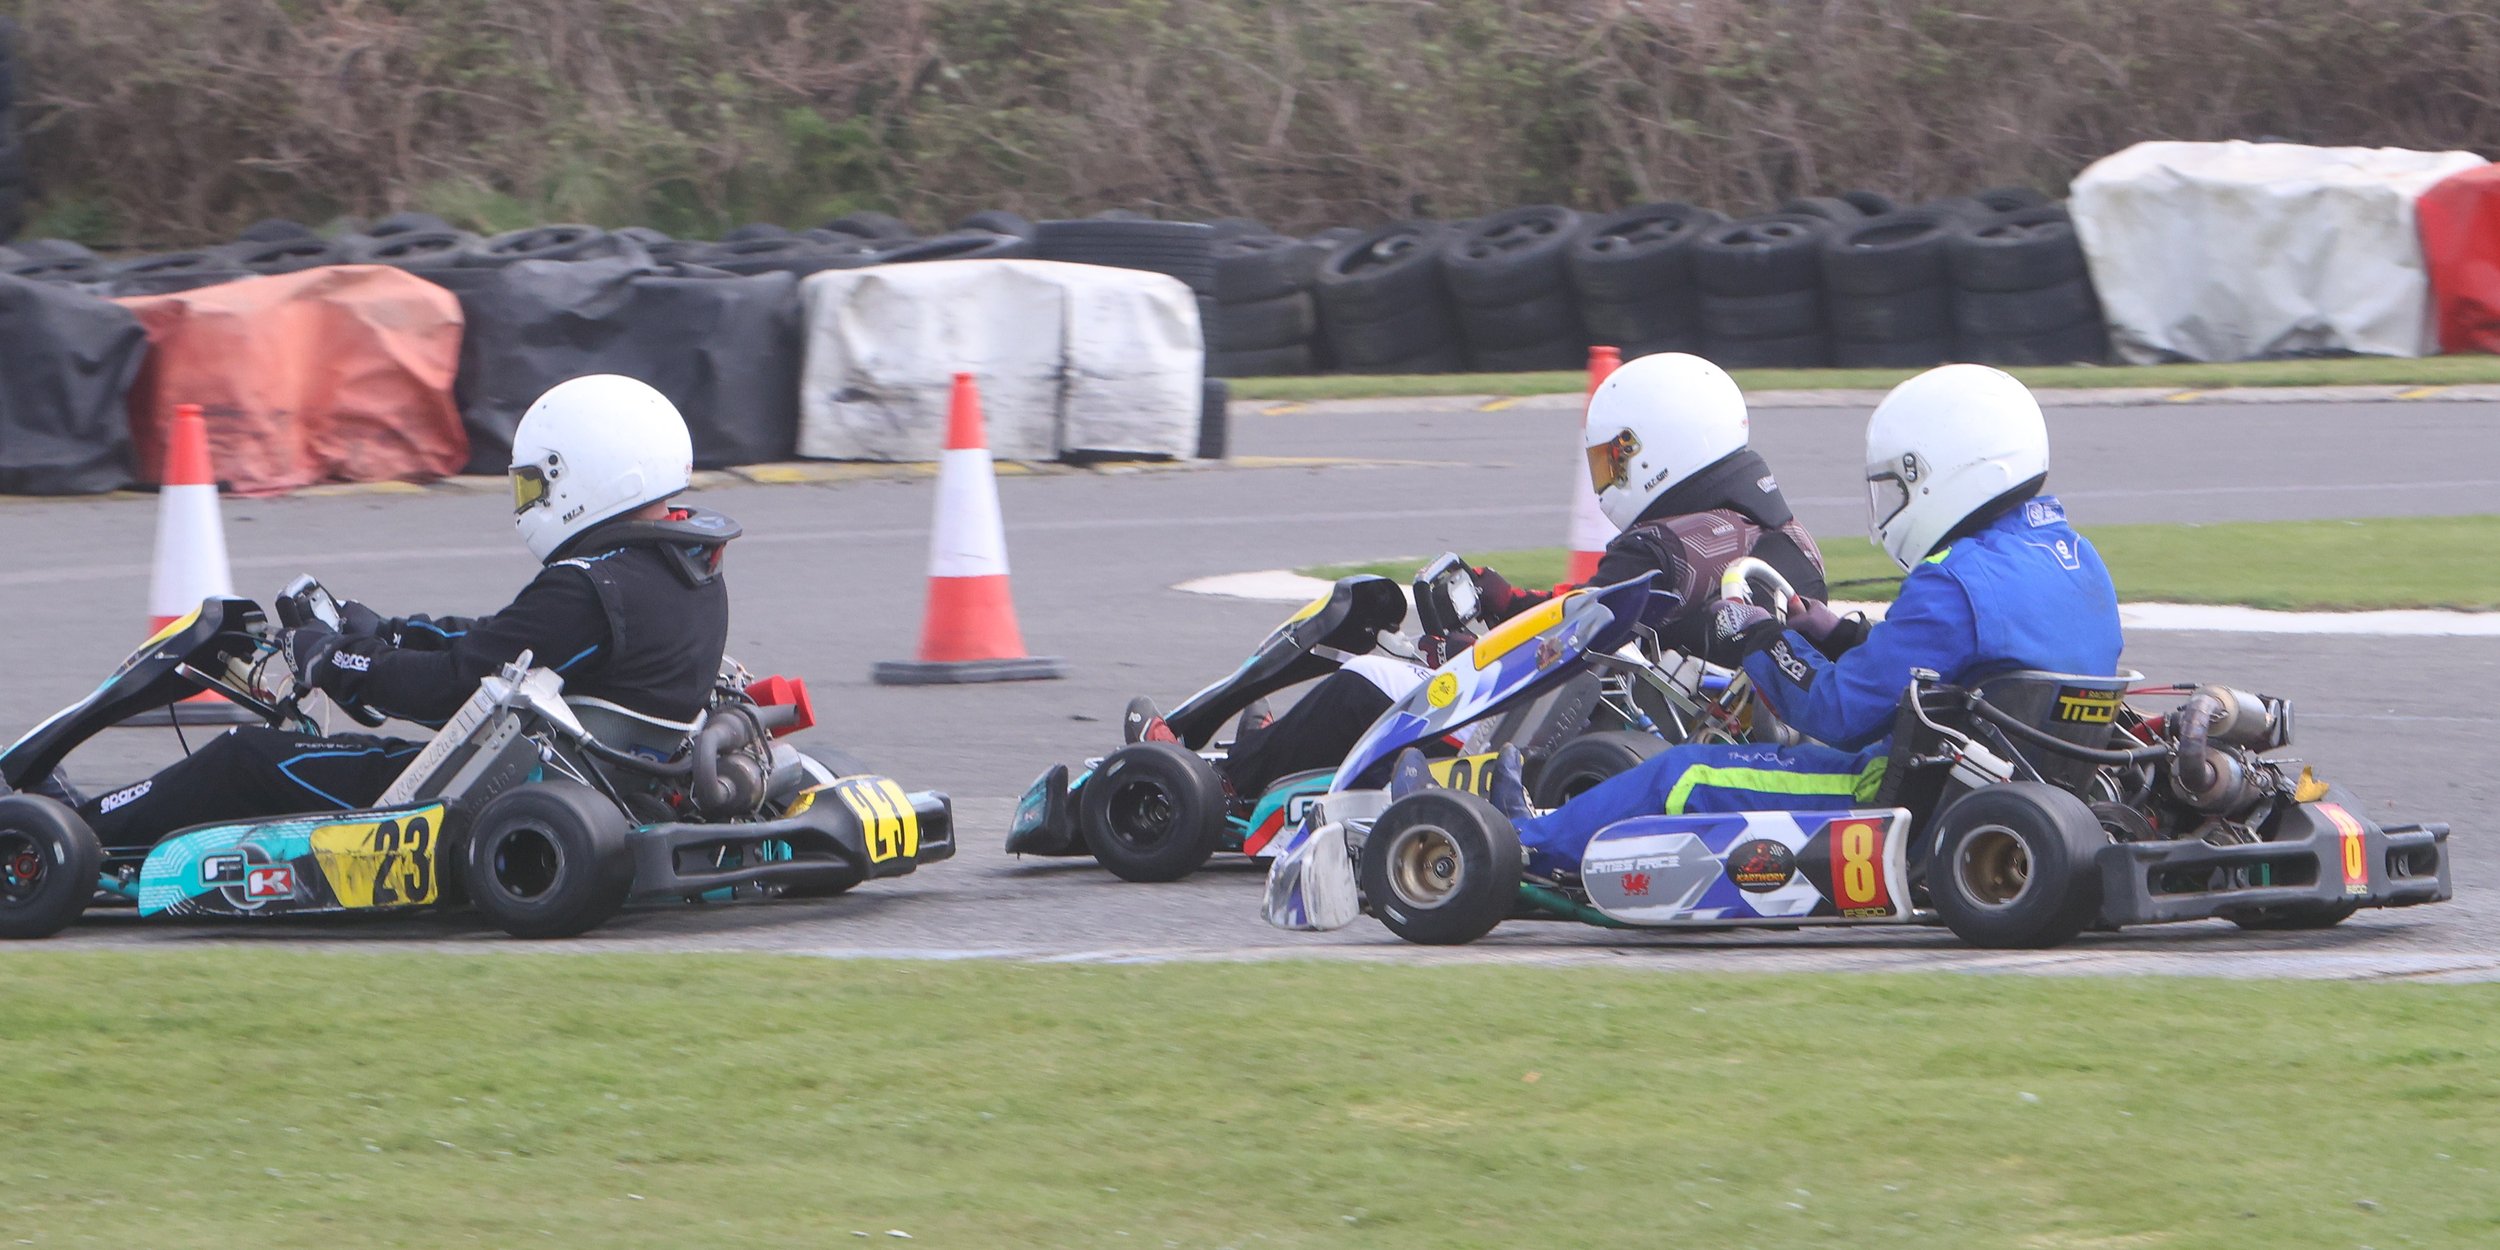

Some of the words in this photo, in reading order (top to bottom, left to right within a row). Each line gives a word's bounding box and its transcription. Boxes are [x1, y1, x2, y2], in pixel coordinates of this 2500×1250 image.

[100, 780, 153, 815] sparco
[372, 816, 430, 905] 23
[1585, 858, 1634, 875] JAMES
[1635, 855, 1681, 871] PRICE
[1841, 823, 1877, 904] 8
[2328, 808, 2363, 880] 8
